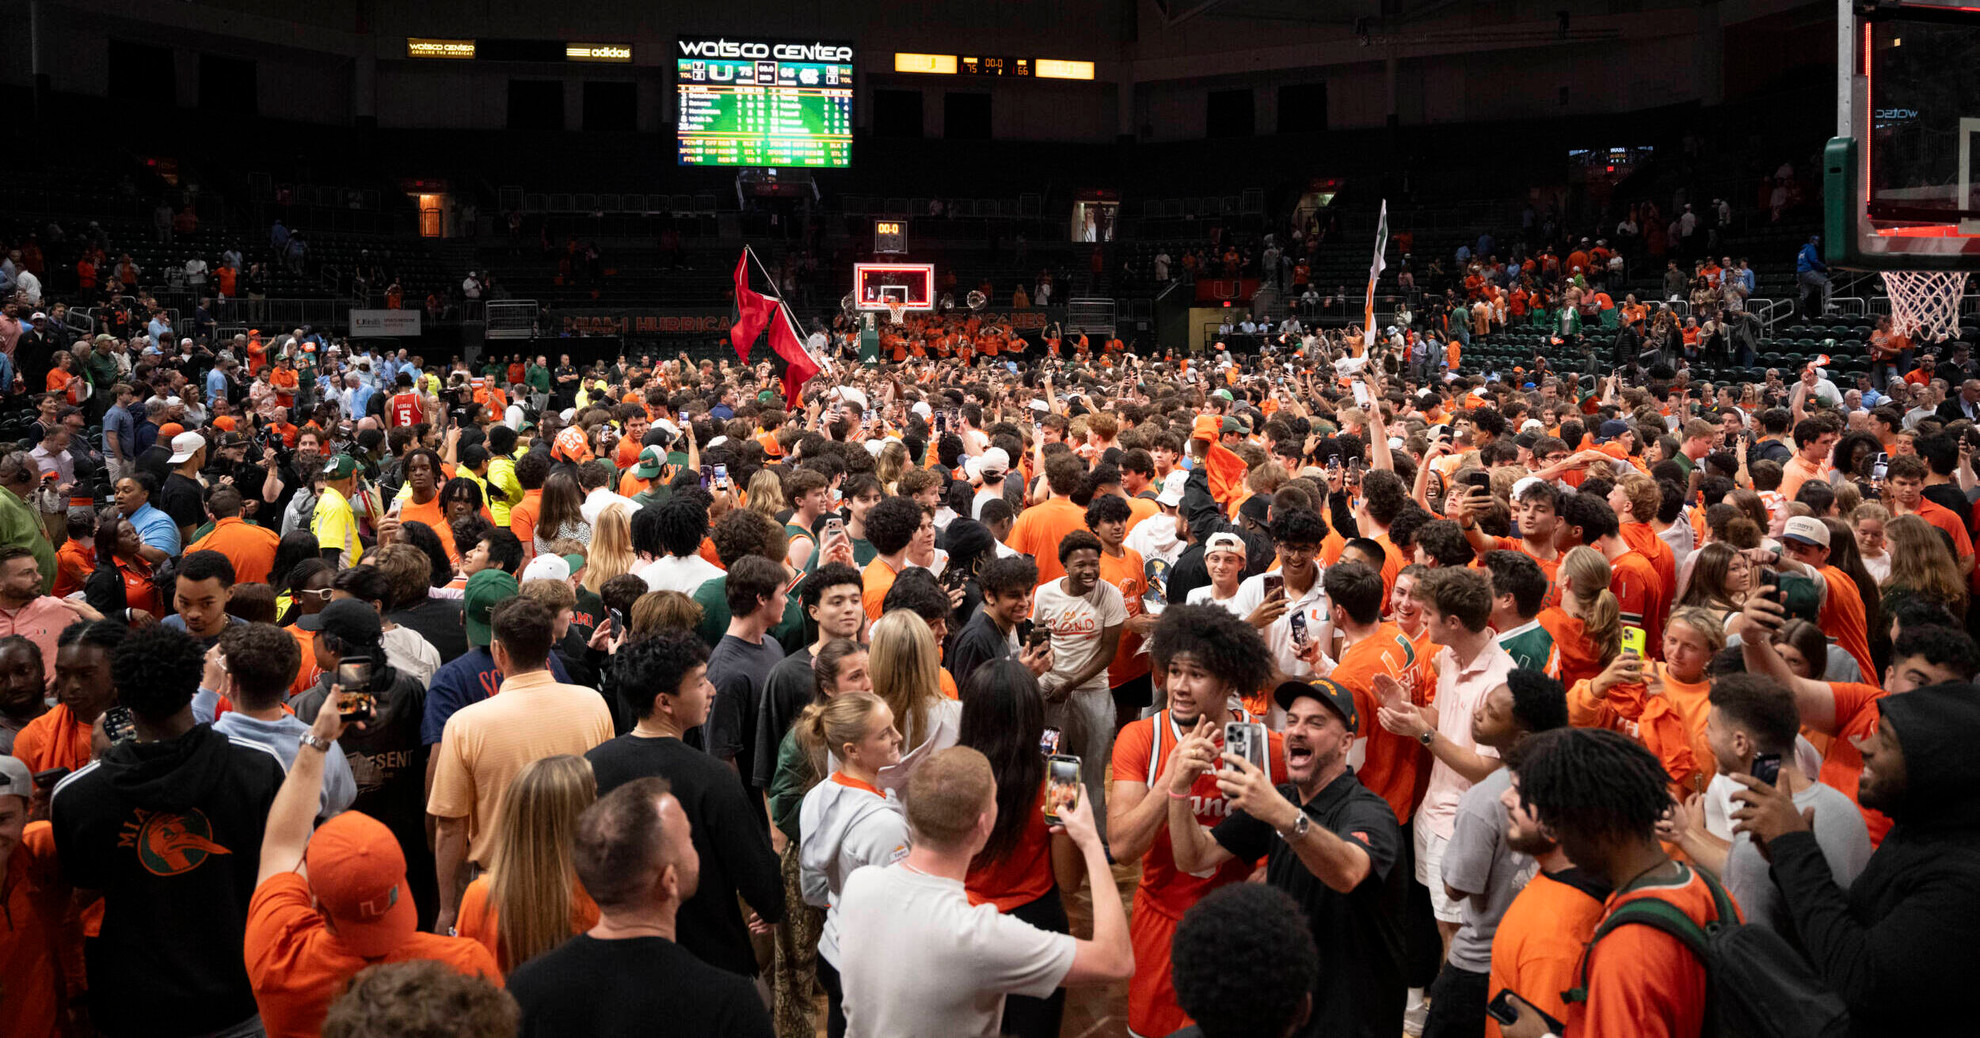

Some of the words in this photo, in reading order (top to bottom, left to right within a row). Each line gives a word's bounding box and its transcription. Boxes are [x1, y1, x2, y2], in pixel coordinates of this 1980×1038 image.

[591, 46, 631, 58] adidas
[967, 64, 978, 74] 75
[1017, 66, 1029, 76] 66
[635, 316, 732, 333] HURRICA
[399, 409, 412, 427] 5
